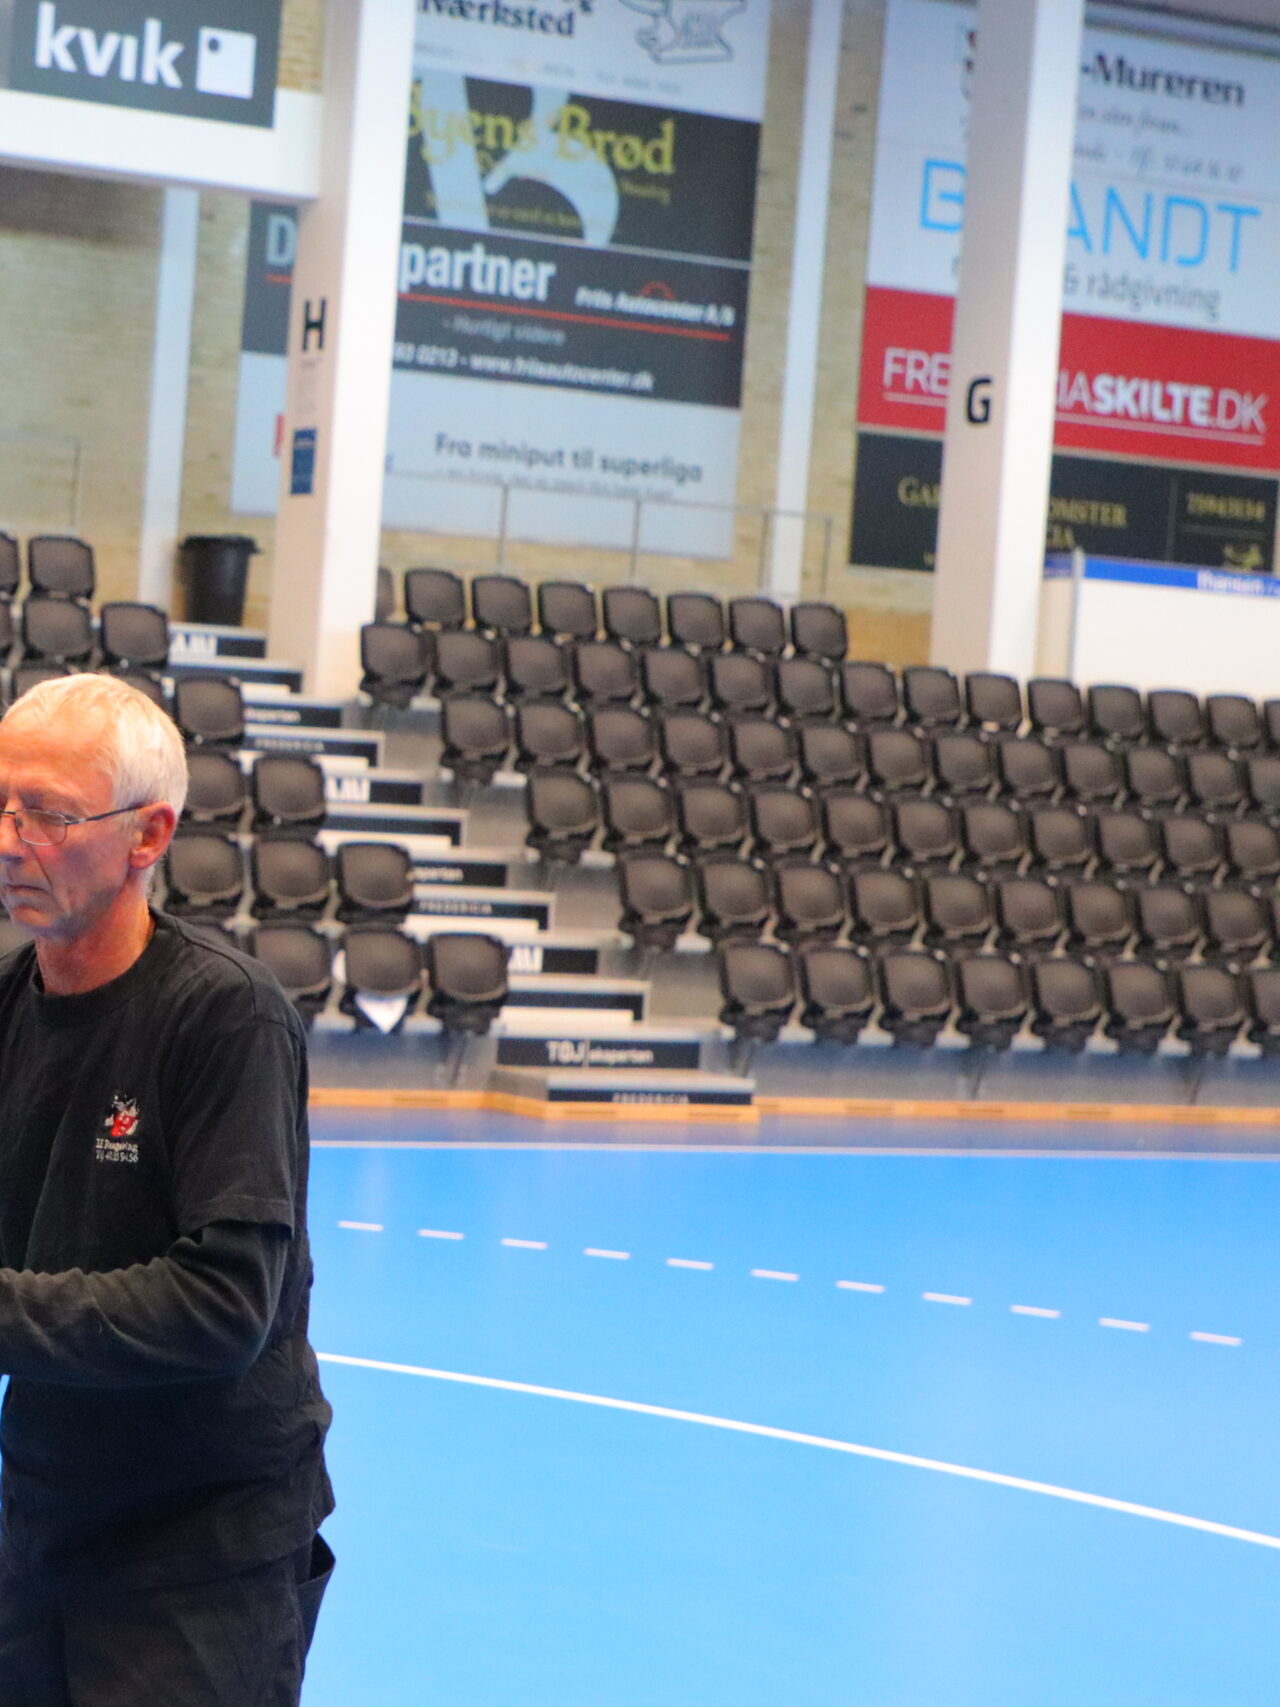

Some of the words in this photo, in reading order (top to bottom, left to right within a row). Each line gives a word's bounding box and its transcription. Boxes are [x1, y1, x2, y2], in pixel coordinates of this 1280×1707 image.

[35, 0, 184, 88] kvik
[547, 103, 677, 176] Brød
[400, 242, 557, 302] partner
[303, 298, 327, 353] H
[965, 377, 995, 425] G
[435, 432, 471, 458] Fra
[477, 439, 565, 469] miniput
[571, 447, 593, 470] til
[600, 454, 704, 487] superliga
